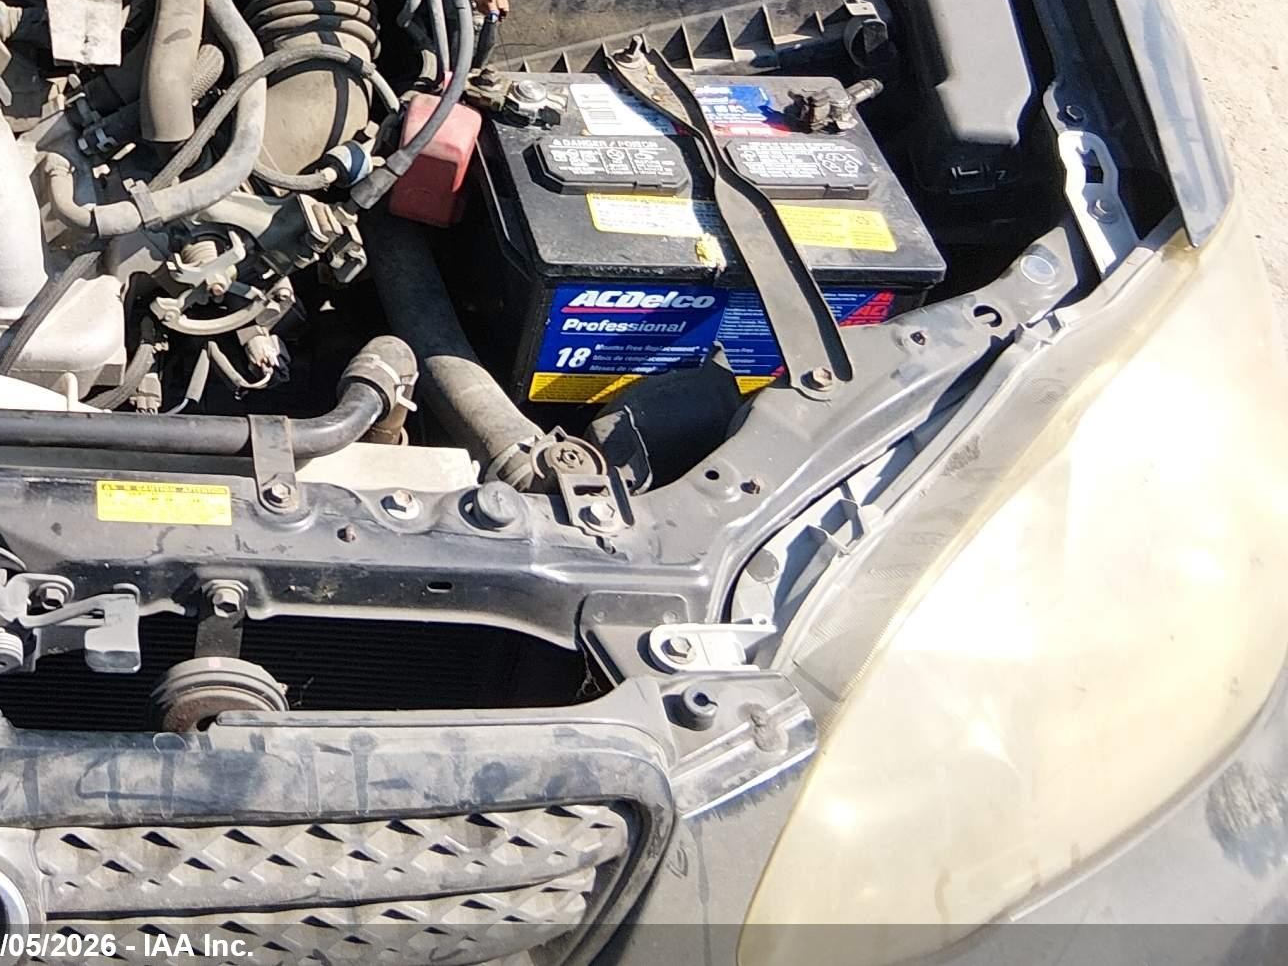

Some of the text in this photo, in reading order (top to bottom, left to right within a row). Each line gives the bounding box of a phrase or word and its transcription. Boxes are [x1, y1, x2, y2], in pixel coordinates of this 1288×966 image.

[562, 139, 608, 148] DANGER
[567, 290, 716, 309] ACDelco
[561, 317, 687, 334] Professional
[555, 347, 592, 369] 18
